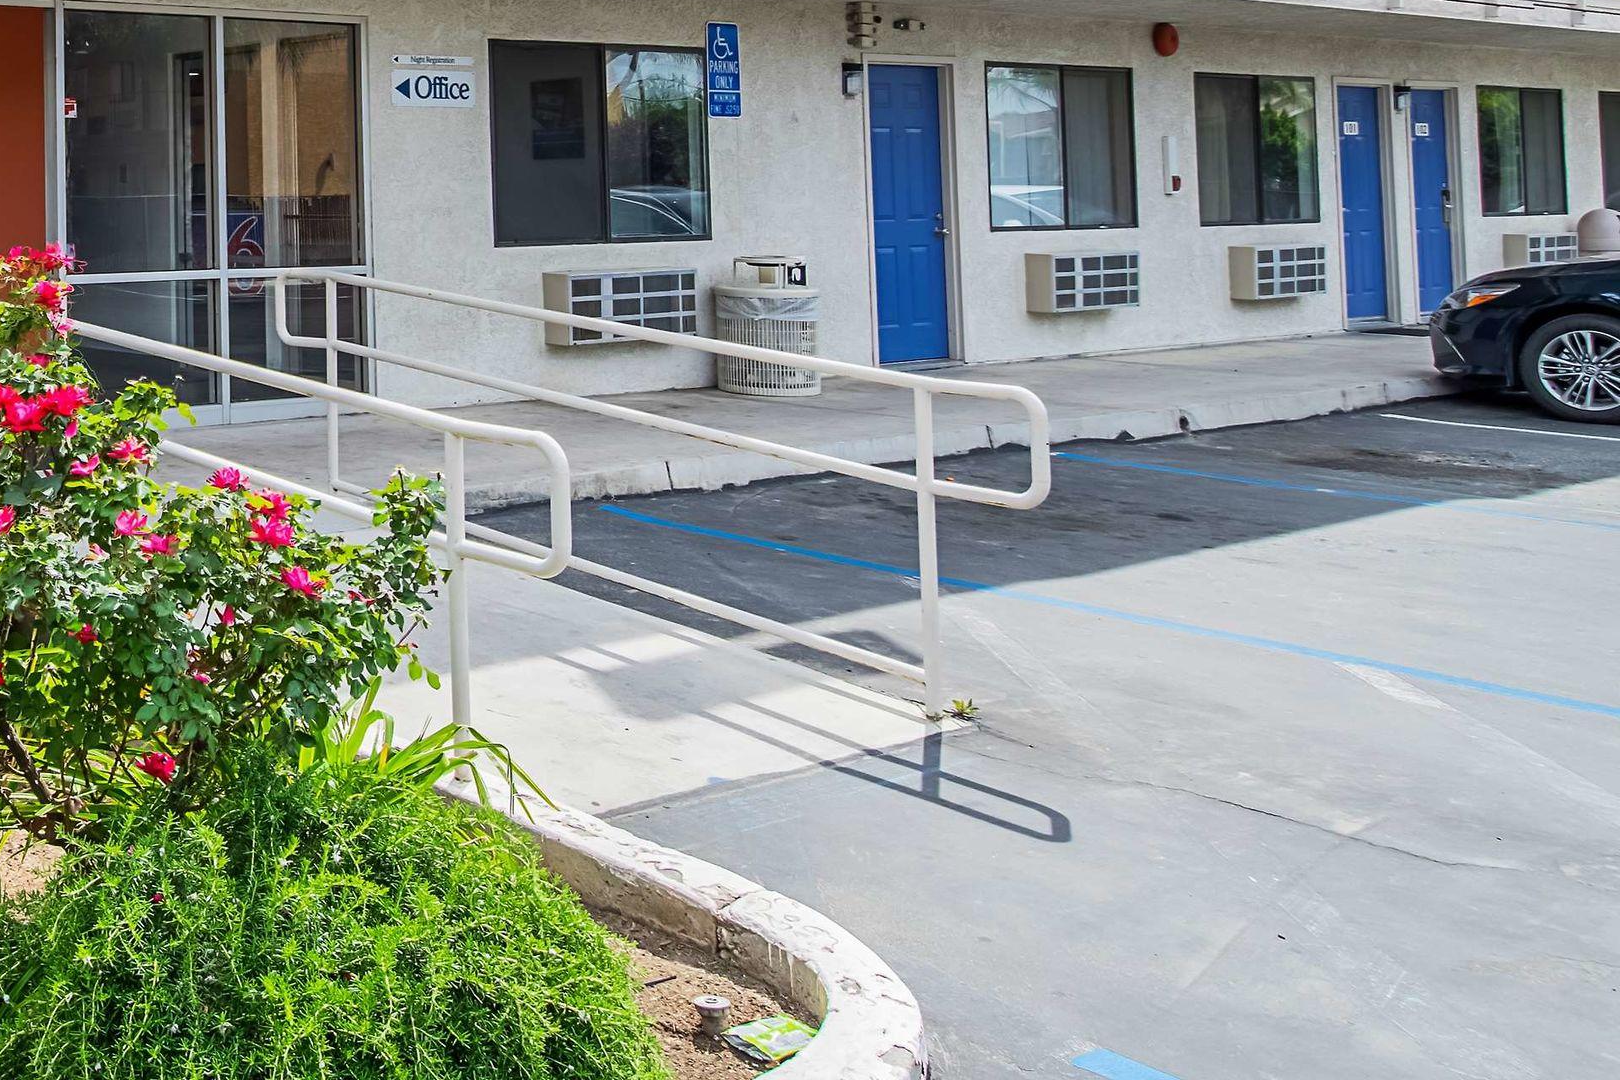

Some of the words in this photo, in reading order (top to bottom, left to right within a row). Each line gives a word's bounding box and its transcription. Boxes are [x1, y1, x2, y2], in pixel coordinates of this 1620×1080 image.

[709, 60, 739, 74] PARKING
[414, 74, 470, 100] Office
[715, 75, 733, 89] ONLY
